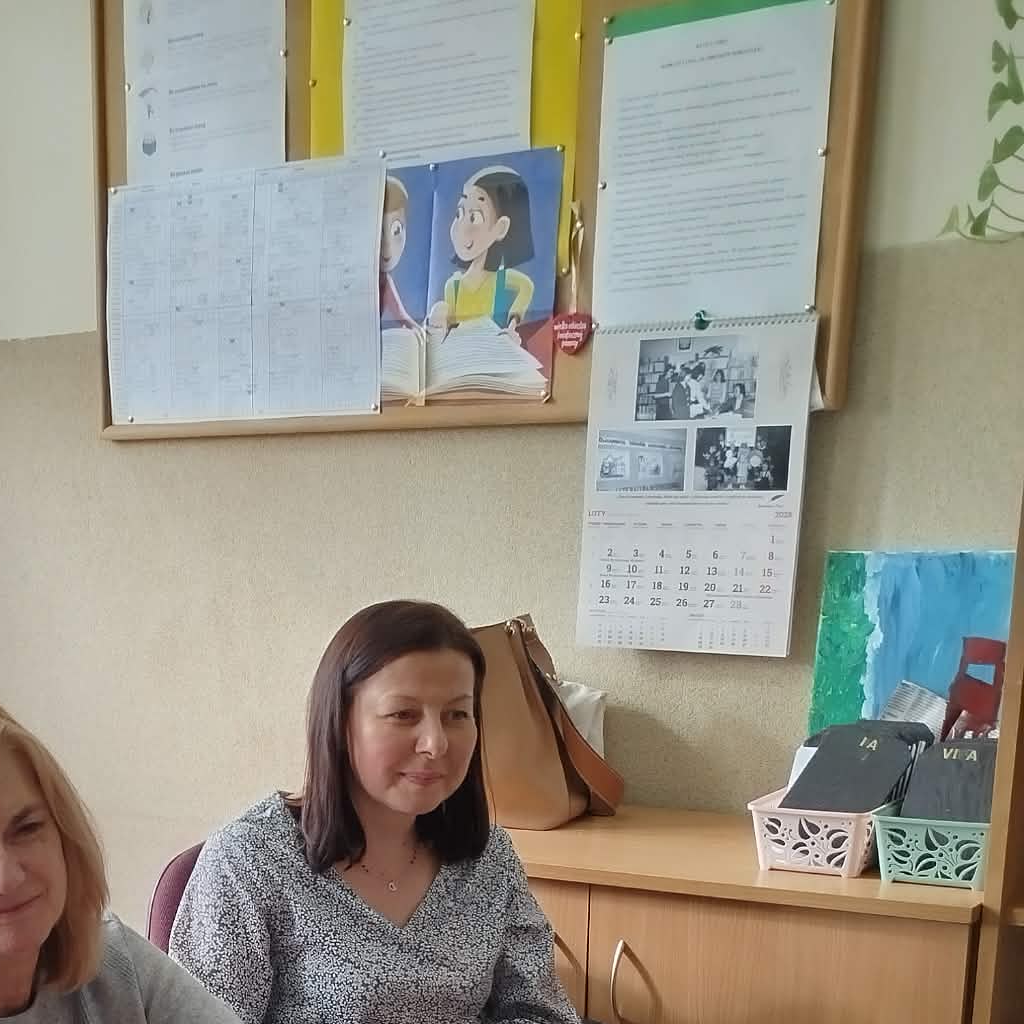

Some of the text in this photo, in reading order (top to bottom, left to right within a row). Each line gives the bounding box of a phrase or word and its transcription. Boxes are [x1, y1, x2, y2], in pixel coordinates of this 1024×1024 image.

[627, 563, 638, 574] 10
[654, 565, 663, 575] 11
[679, 565, 691, 575] 12
[706, 566, 718, 576] 13
[762, 567, 773, 578] 15
[601, 579, 772, 594] 16 17 18 19 20 21 22
[598, 595, 610, 604] 23
[623, 595, 635, 605] 24
[649, 597, 662, 607] 25
[675, 598, 688, 608] 26
[703, 599, 715, 609] 27
